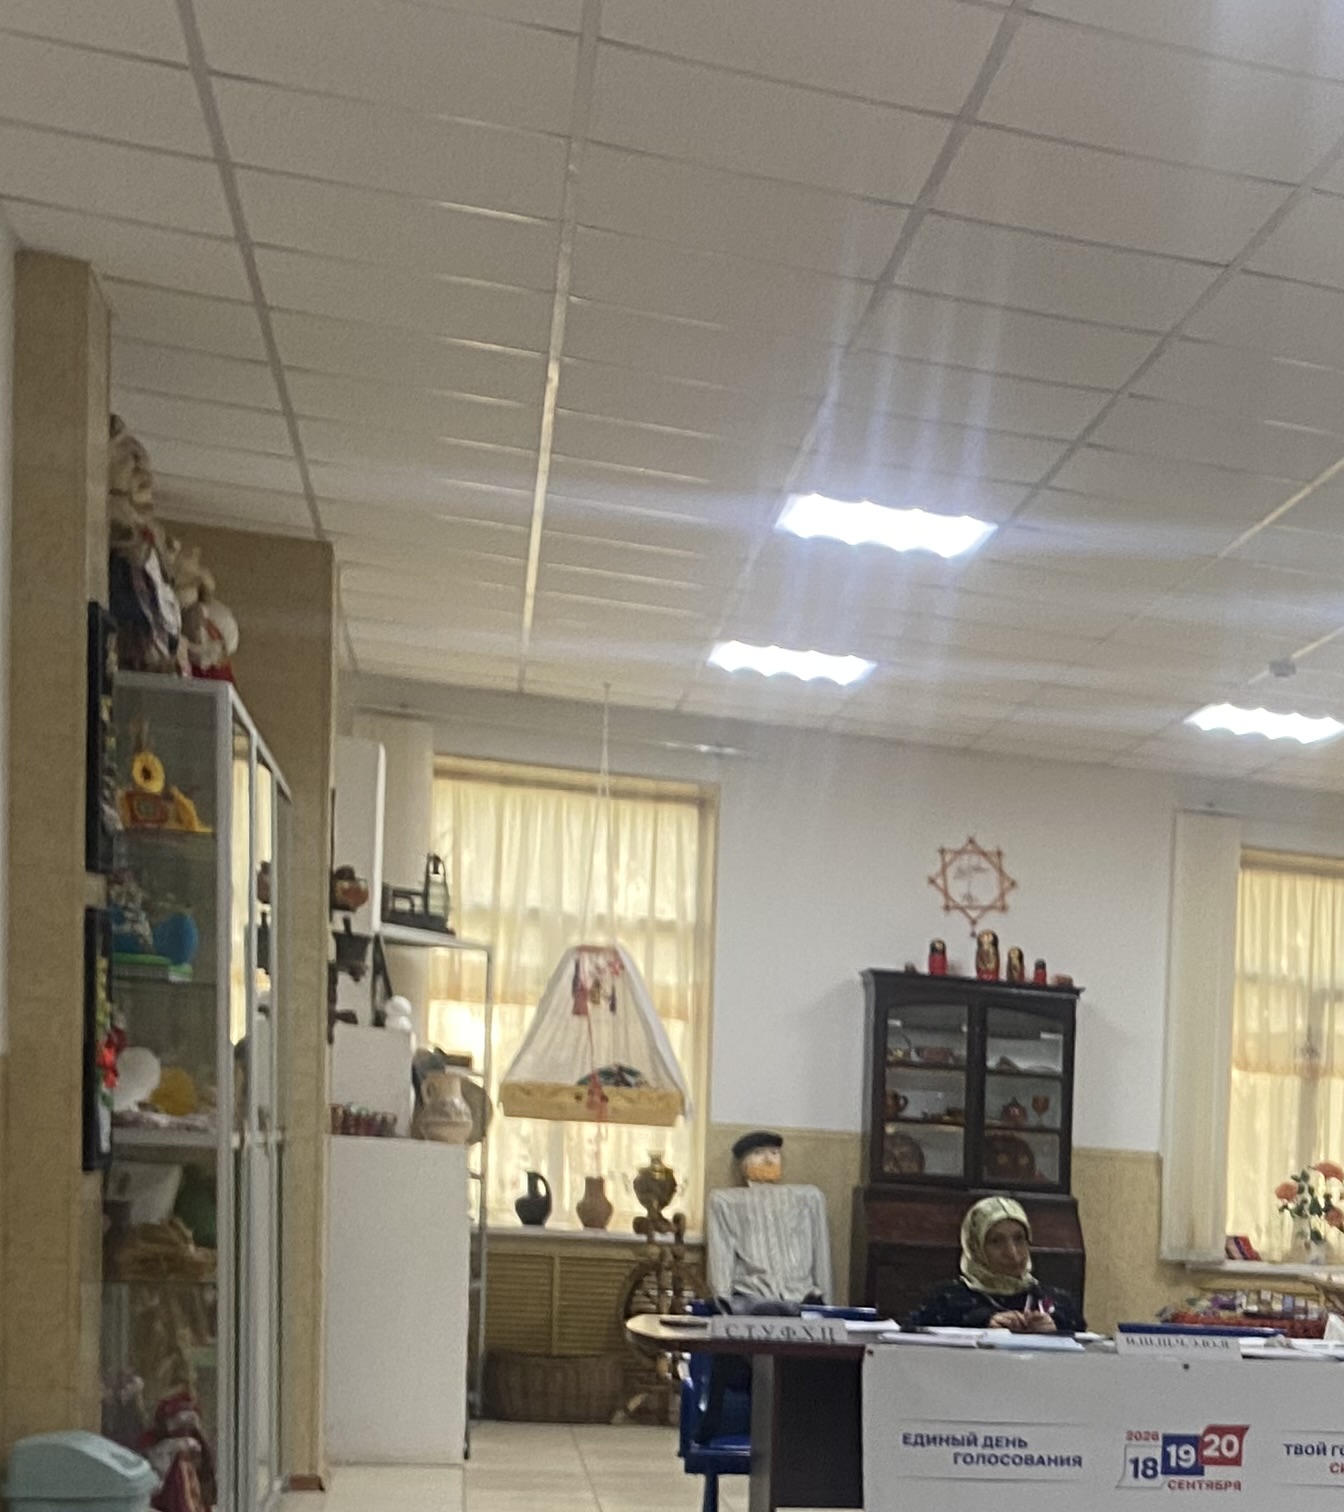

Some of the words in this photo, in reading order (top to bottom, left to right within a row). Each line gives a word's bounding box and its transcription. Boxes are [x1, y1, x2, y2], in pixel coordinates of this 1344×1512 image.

[902, 1432, 978, 1447] ЕДИНЫЙ
[982, 1435, 1028, 1449] ДЕНЬ
[1129, 1456, 1159, 1479] 18
[1167, 1444, 1196, 1468] 19
[1203, 1433, 1239, 1458] 20
[1283, 1442, 1327, 1456] ТВОЙ
[953, 1452, 1082, 1468] ГОЛОСОВАНИЯ
[1167, 1479, 1241, 1492] СЕНТЯБРЯ
